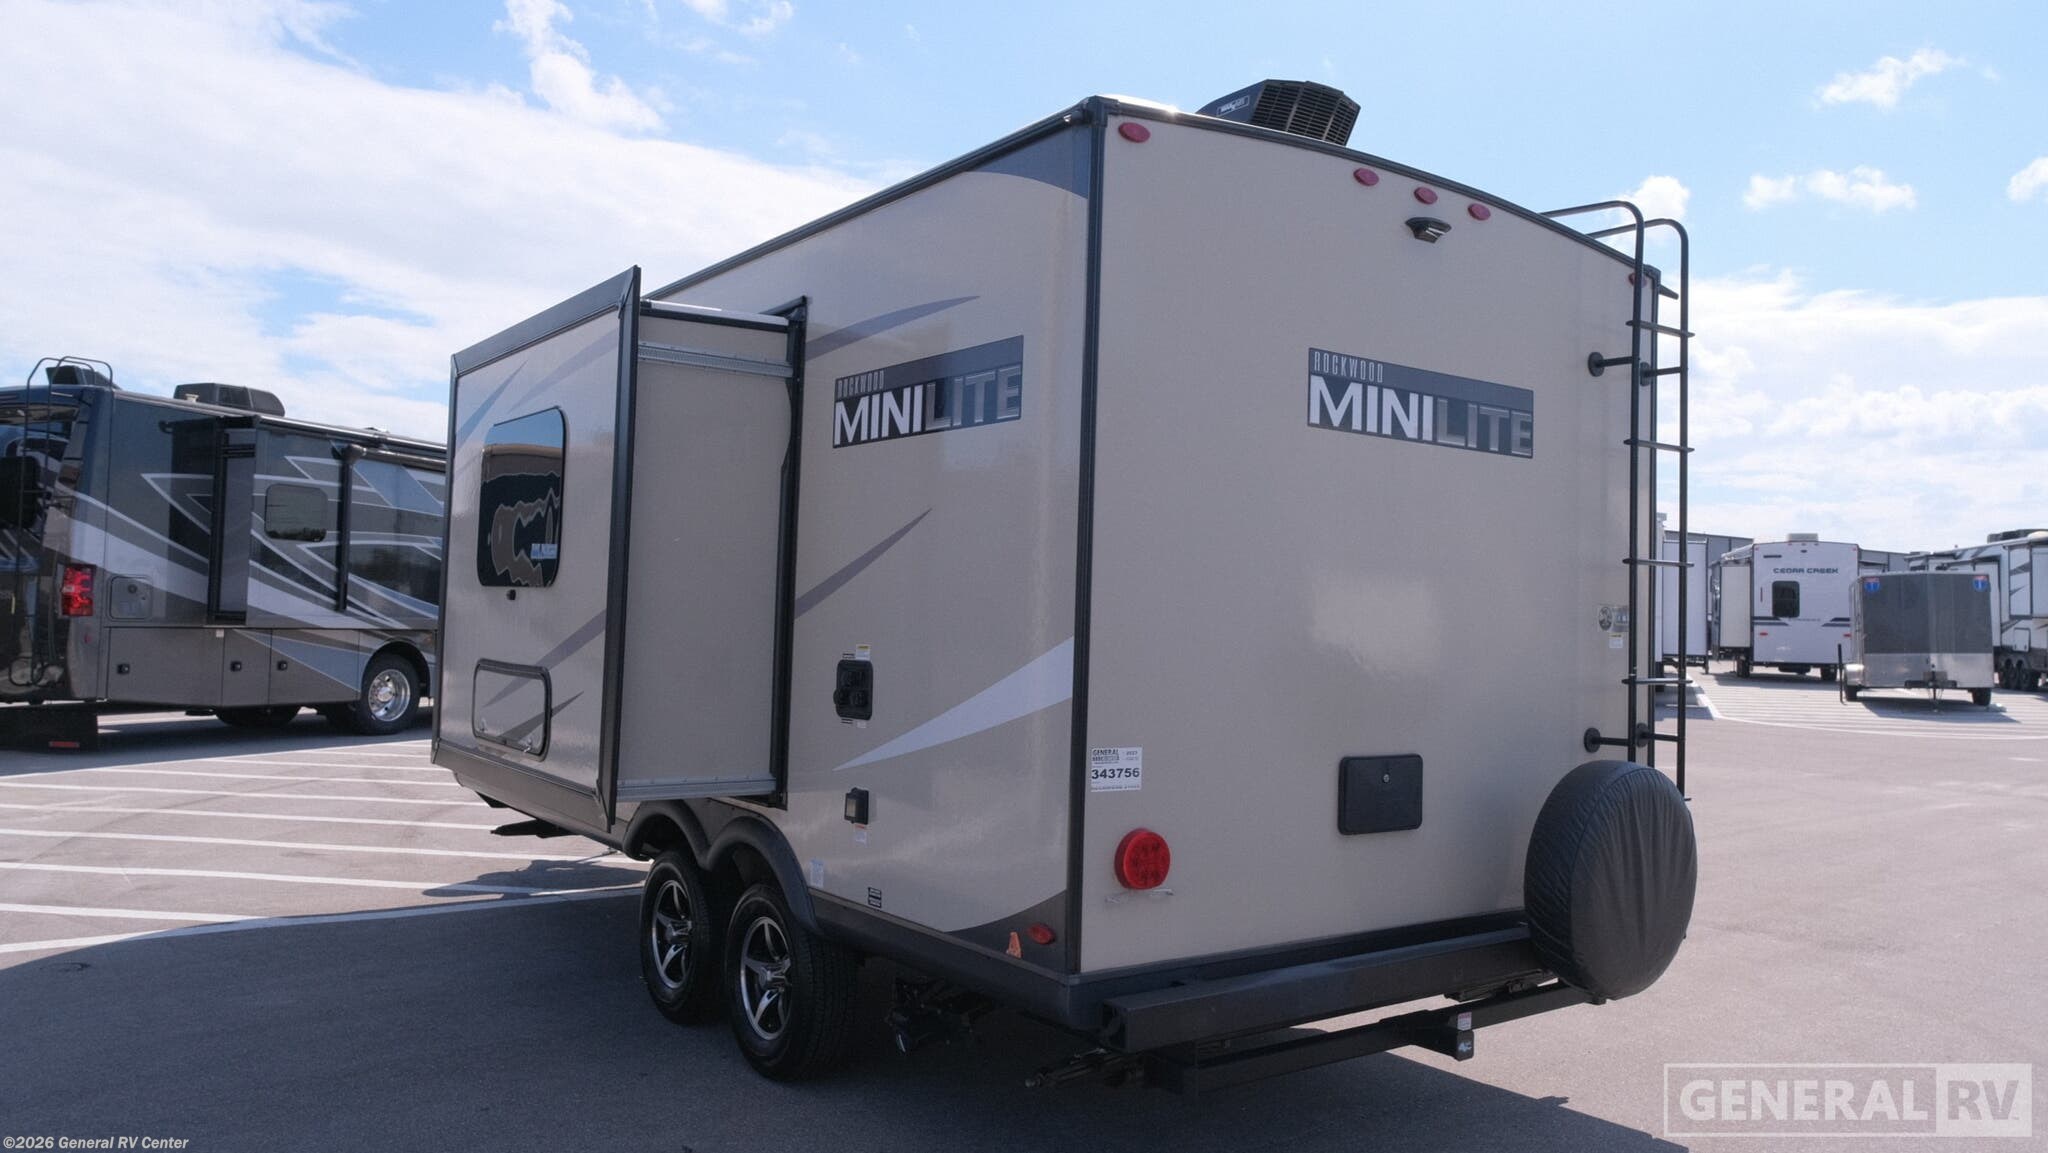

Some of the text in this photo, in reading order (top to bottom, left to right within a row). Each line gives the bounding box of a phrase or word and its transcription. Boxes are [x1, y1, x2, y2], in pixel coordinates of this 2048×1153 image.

[1313, 351, 1384, 383] ROCKWOOD
[837, 370, 885, 398] ROCKWOOD
[1091, 767, 1140, 780] 343756
